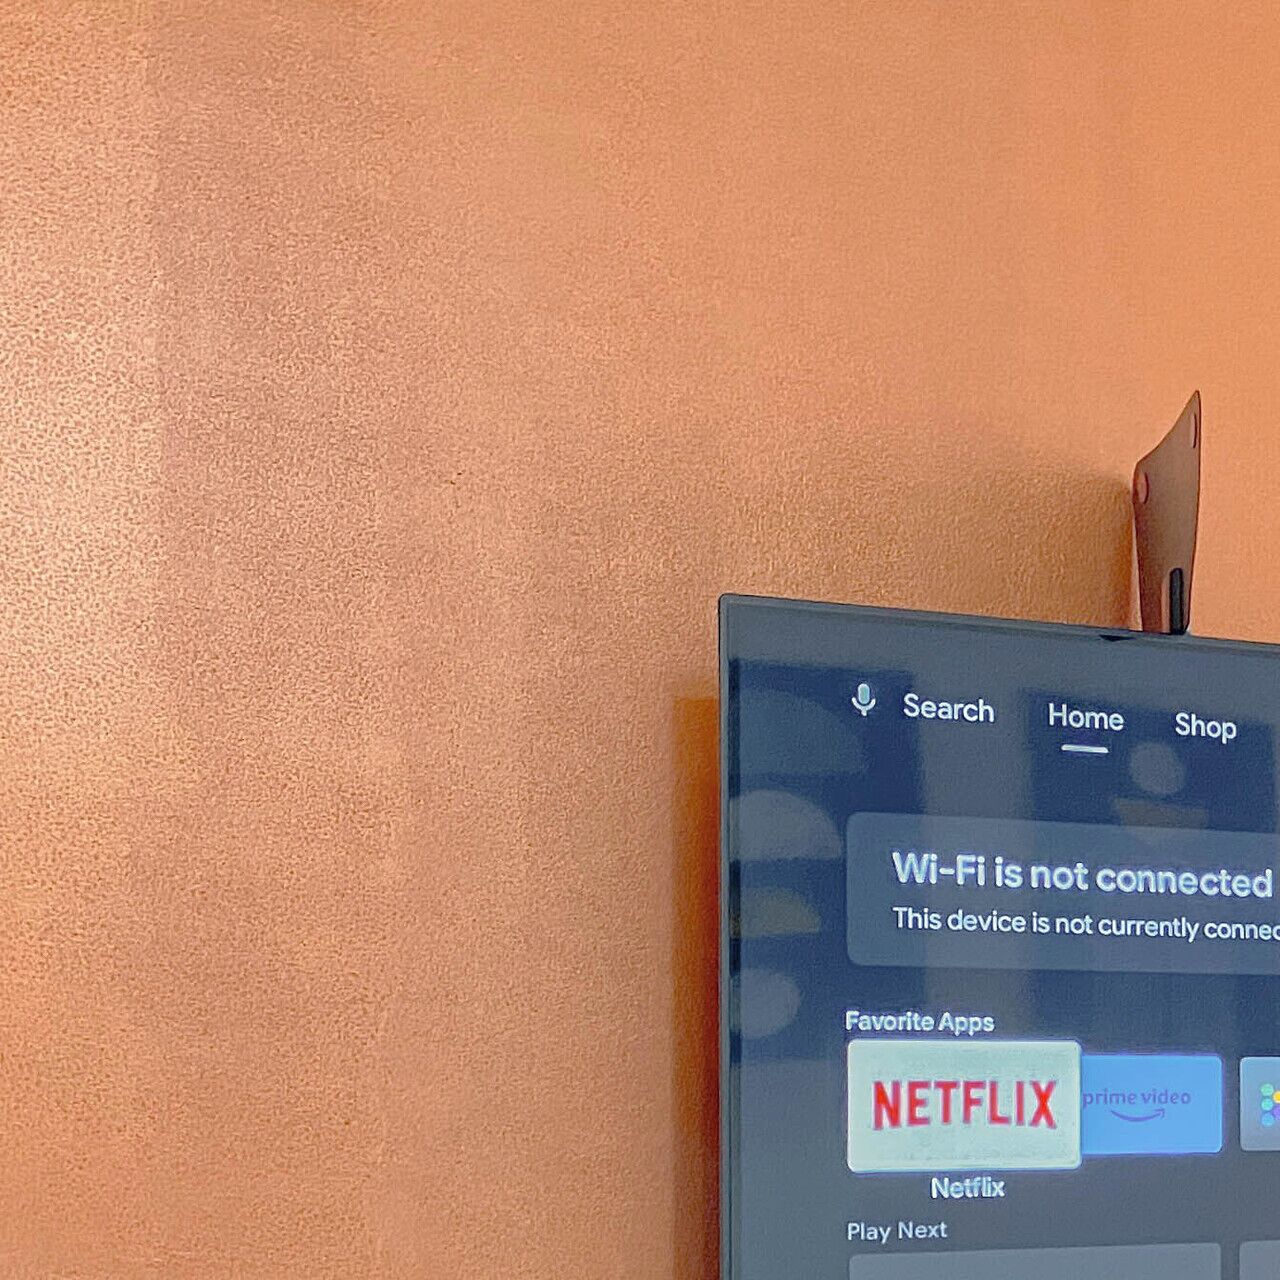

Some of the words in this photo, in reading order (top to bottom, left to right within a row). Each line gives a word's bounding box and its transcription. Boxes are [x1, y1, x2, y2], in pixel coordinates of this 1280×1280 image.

[903, 693, 995, 722] Search
[1048, 703, 1125, 731] Home
[1175, 713, 1238, 744] Shop
[892, 851, 987, 887] Wi-Fi
[994, 856, 1023, 888] is
[1030, 862, 1090, 891] not
[1096, 868, 1274, 899] connected
[893, 906, 943, 930] This
[946, 909, 1027, 934] device
[1032, 912, 1051, 934] is
[1055, 915, 1094, 936] not
[1098, 915, 1199, 943] currently
[845, 1010, 936, 1031] Favorite
[937, 1011, 996, 1036] Apps
[872, 1080, 1057, 1130] NETFLIX
[1082, 1089, 1137, 1108] prime
[1140, 1088, 1192, 1106] video
[931, 1177, 1006, 1199] Netflix
[847, 1223, 891, 1244] Play
[898, 1221, 948, 1239] Next
